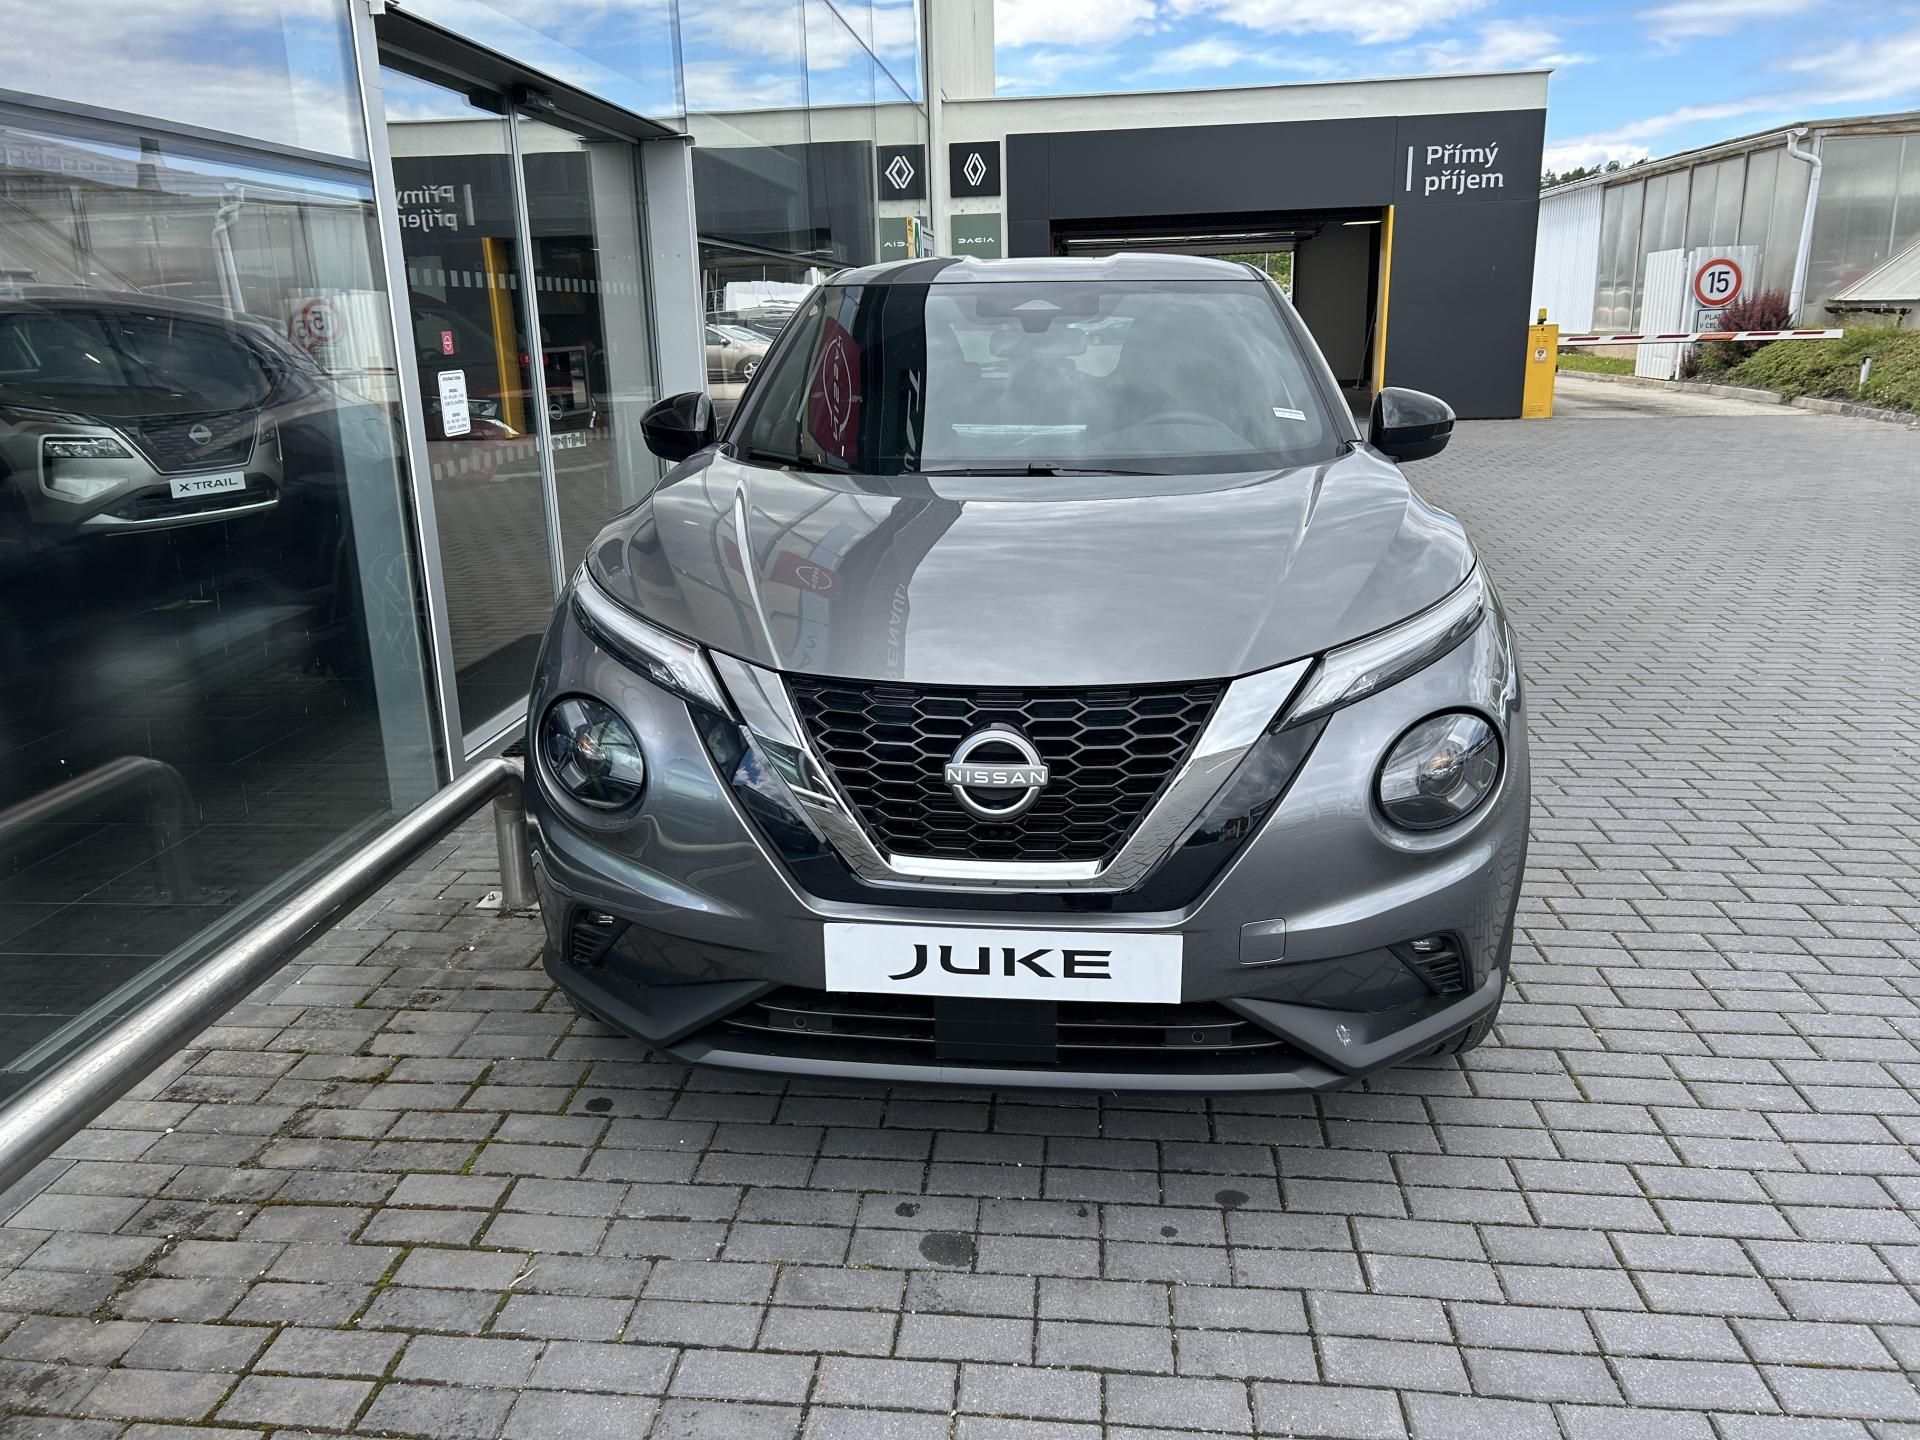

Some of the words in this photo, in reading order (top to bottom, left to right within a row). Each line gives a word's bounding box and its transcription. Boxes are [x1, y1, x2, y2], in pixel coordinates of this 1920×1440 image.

[1426, 141, 1499, 168] Přímý
[1424, 169, 1504, 196] příjem
[1708, 271, 1731, 293] 15
[180, 483, 190, 492] X
[193, 478, 238, 490] TRAIL
[947, 768, 1045, 784] NISSAN
[888, 944, 1113, 981] JUKE
